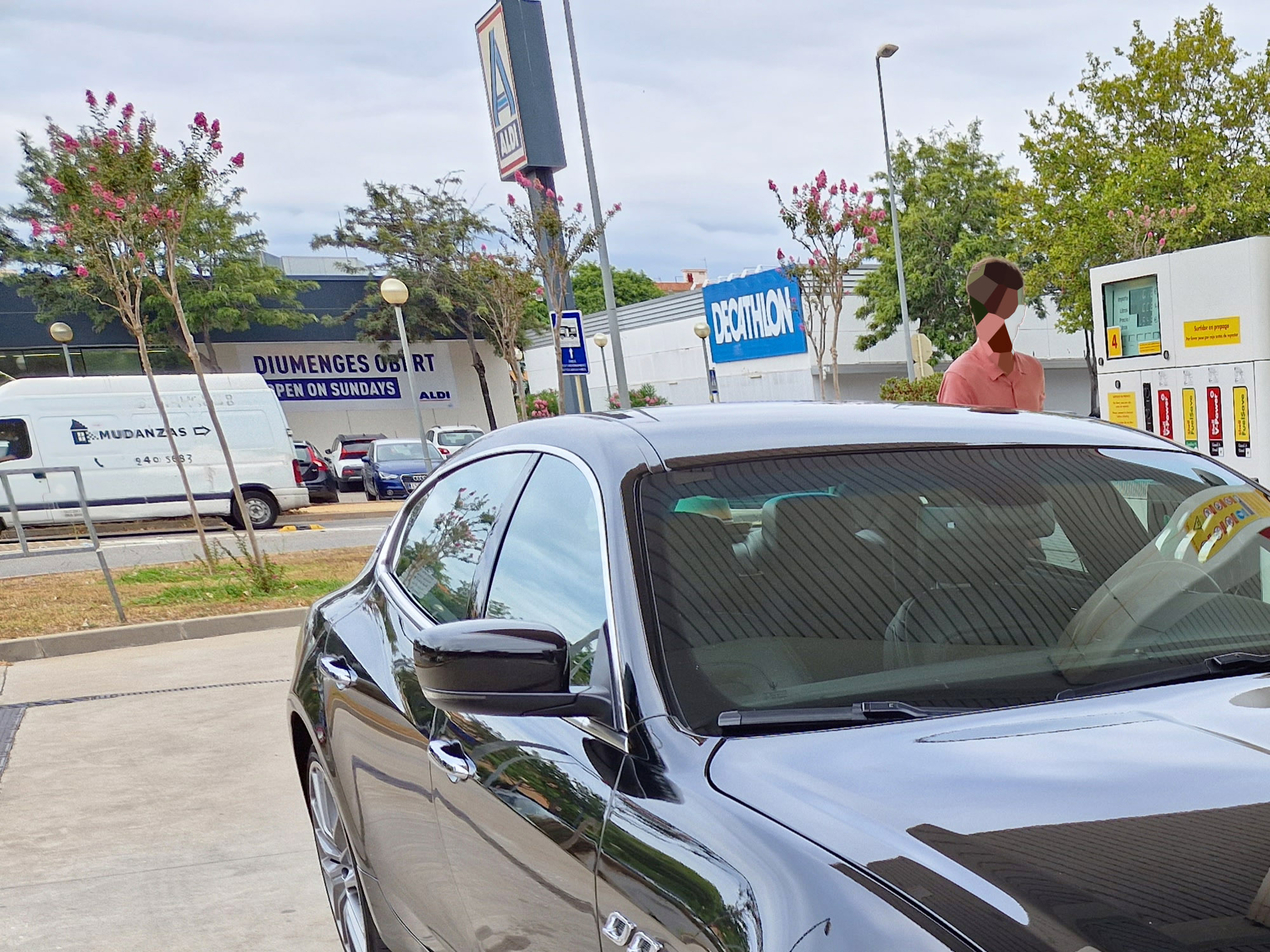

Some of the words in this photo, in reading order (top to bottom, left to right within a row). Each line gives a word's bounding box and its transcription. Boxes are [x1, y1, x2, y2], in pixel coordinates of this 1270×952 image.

[500, 122, 521, 158] ALDI
[711, 286, 794, 345] DECATHLON
[1112, 334, 1118, 349] 4
[253, 355, 370, 375] DIUMENGES
[307, 382, 328, 397] ON
[330, 381, 396, 396] SUNDAYS
[419, 391, 450, 399] ALDI
[99, 427, 187, 440] MUDANZAS
